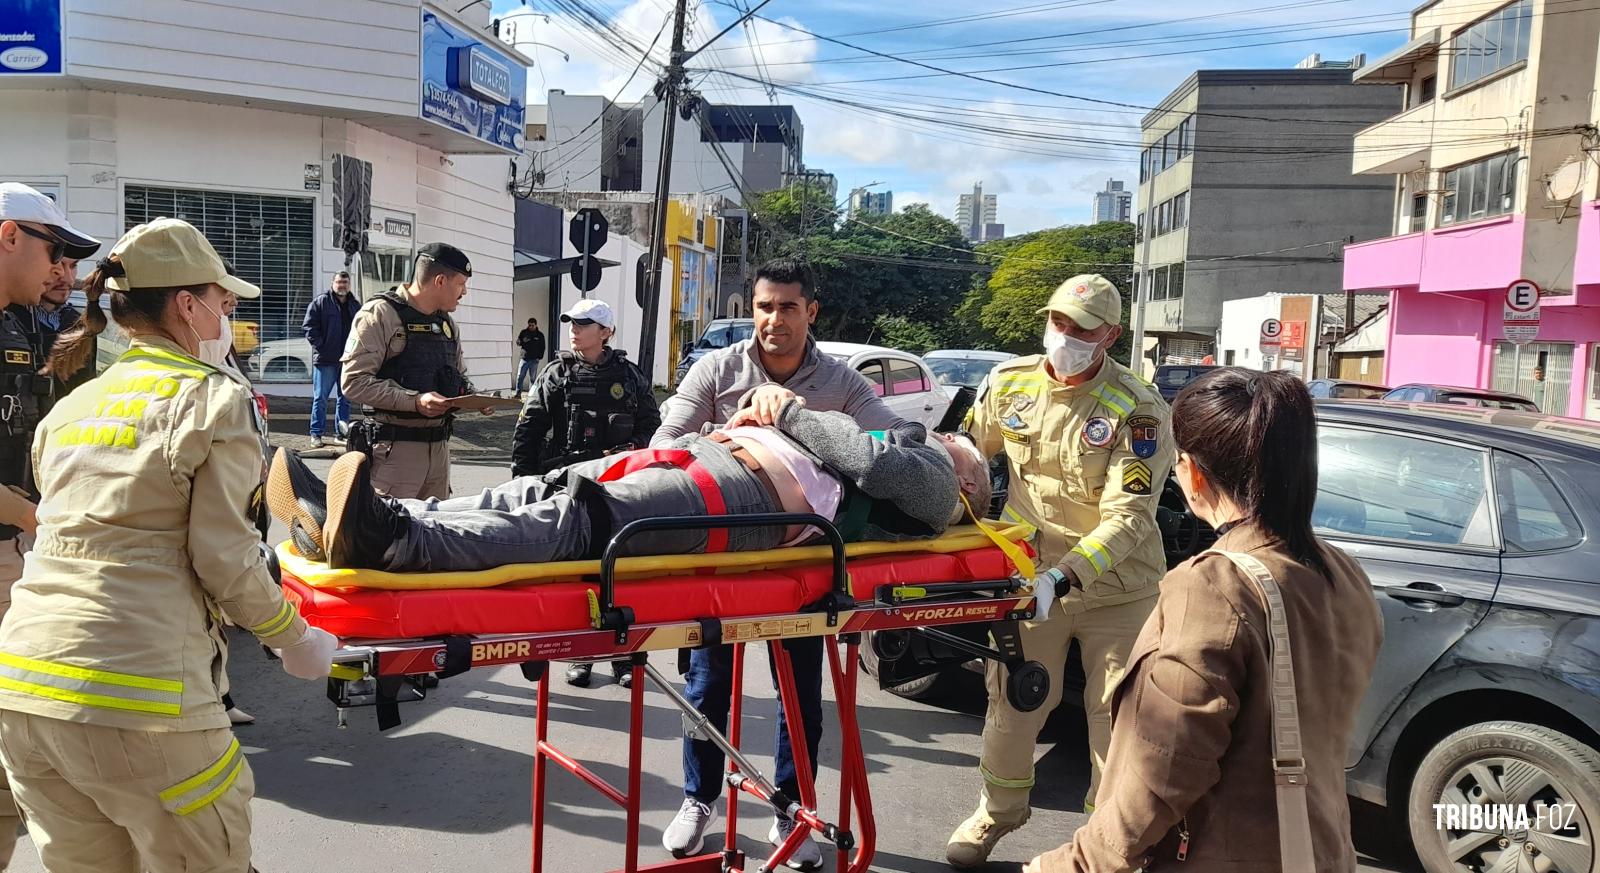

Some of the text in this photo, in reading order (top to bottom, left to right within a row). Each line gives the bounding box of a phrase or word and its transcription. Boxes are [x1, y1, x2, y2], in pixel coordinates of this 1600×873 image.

[6, 53, 42, 63] Carrier
[475, 61, 507, 93] TOTALFOZ
[387, 222, 410, 236] TOTALFOZ
[1516, 286, 1530, 305] E
[1268, 322, 1276, 333] E
[914, 606, 998, 621] FORZA RESCUE
[472, 640, 531, 662] BMPR
